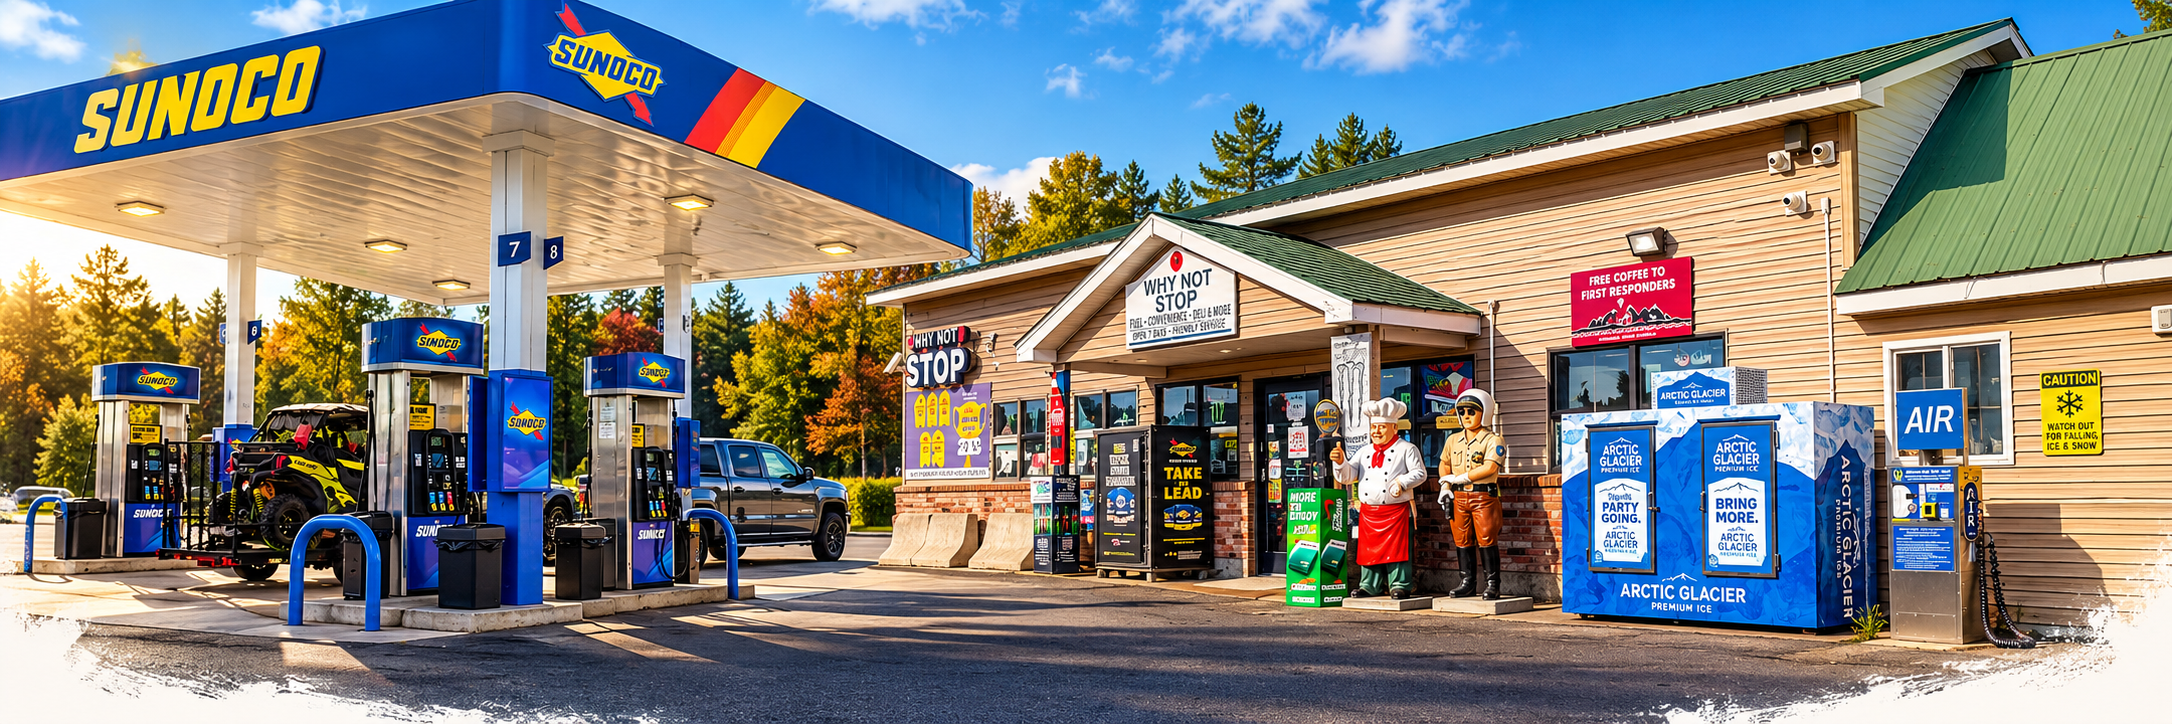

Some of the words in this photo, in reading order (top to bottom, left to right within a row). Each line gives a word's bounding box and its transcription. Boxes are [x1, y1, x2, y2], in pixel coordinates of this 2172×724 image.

[554, 38, 658, 91] SUNOCO
[73, 45, 322, 154] SUNOCO
[509, 241, 520, 258] 7
[550, 244, 558, 260] 8
[1144, 275, 1177, 296] WHY
[1181, 268, 1212, 290] NOT
[1589, 274, 1611, 286] FREE
[1613, 268, 1649, 283] COFFEE
[1651, 266, 1665, 278] TO
[1581, 287, 1607, 301] FIRST
[1609, 278, 1676, 297] RESPONDERS
[1155, 289, 1198, 313] STOP
[914, 332, 934, 349] WHY
[936, 327, 958, 345] NOT
[906, 348, 965, 387] STOP
[2043, 372, 2097, 386] CAUTION
[1660, 390, 1690, 400] ARCTIC
[1690, 388, 1726, 399] GLACIER
[1904, 405, 1954, 434] AIR
[2047, 422, 2076, 431] WATCH
[2078, 421, 2095, 430] OUT
[2046, 432, 2062, 441] FOR
[1602, 444, 1639, 456] ARCTIC
[1716, 441, 1757, 453] ARCTIC
[2047, 442, 2060, 451] ICE
[2071, 441, 2097, 450] SNOW
[1600, 455, 1642, 467] GLACIER
[1713, 453, 1760, 465] GLACIER
[1164, 466, 1203, 480] TAKE
[1164, 486, 1203, 500] LEAD
[1290, 492, 1316, 502] MORE
[1841, 455, 1852, 530] ARCTIC
[1602, 502, 1639, 513] PARTY
[1715, 498, 1757, 510] BRING
[1601, 513, 1641, 524] GOING.
[1715, 511, 1759, 523] MORE.
[1605, 531, 1636, 540] ARCTIC
[1720, 533, 1755, 542] ARCTIC
[1603, 540, 1638, 549] GLACIER
[1717, 542, 1758, 552] GLACIER
[1842, 536, 1853, 618] GLACIER
[1620, 583, 1675, 600] ARCTIC
[1679, 586, 1746, 603] GLACIER
[1651, 602, 1693, 612] PREMIUM
[1696, 604, 1712, 613] ICE
